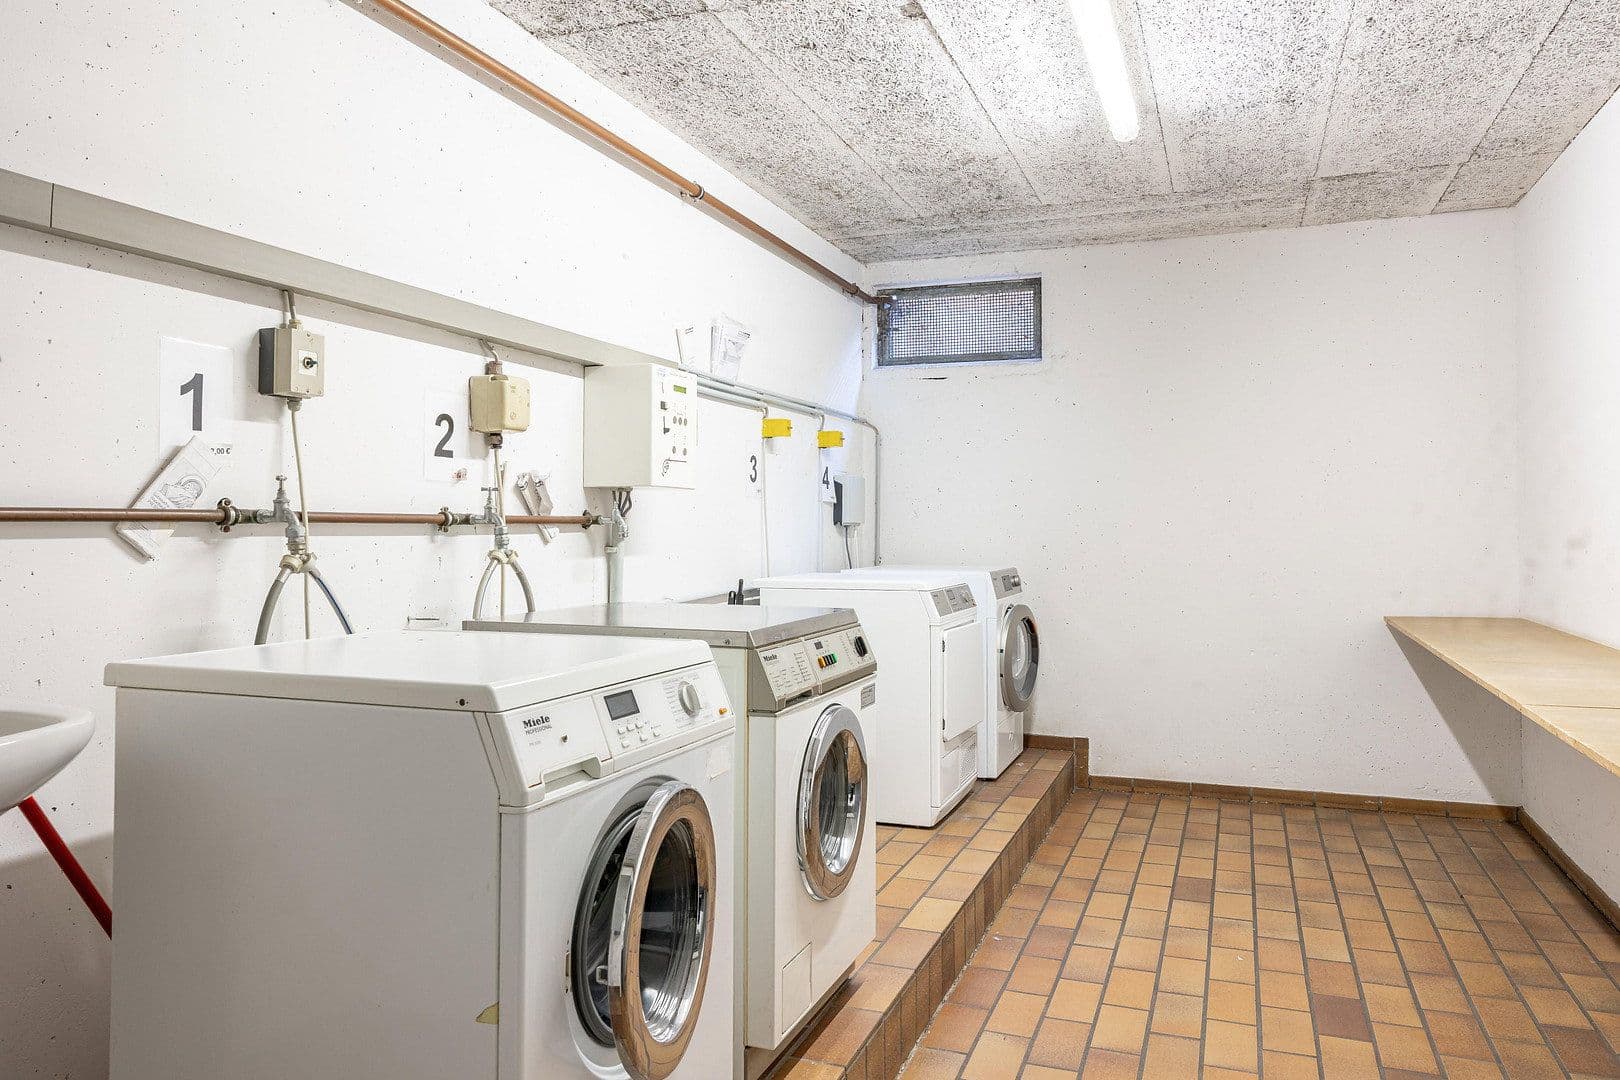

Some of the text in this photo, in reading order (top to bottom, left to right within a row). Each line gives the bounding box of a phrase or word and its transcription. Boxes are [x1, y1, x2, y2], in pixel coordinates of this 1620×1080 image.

[180, 372, 203, 431] 1
[434, 413, 454, 459] 2
[749, 455, 757, 483] 3
[822, 466, 830, 489] 4
[522, 715, 551, 729] Miele
